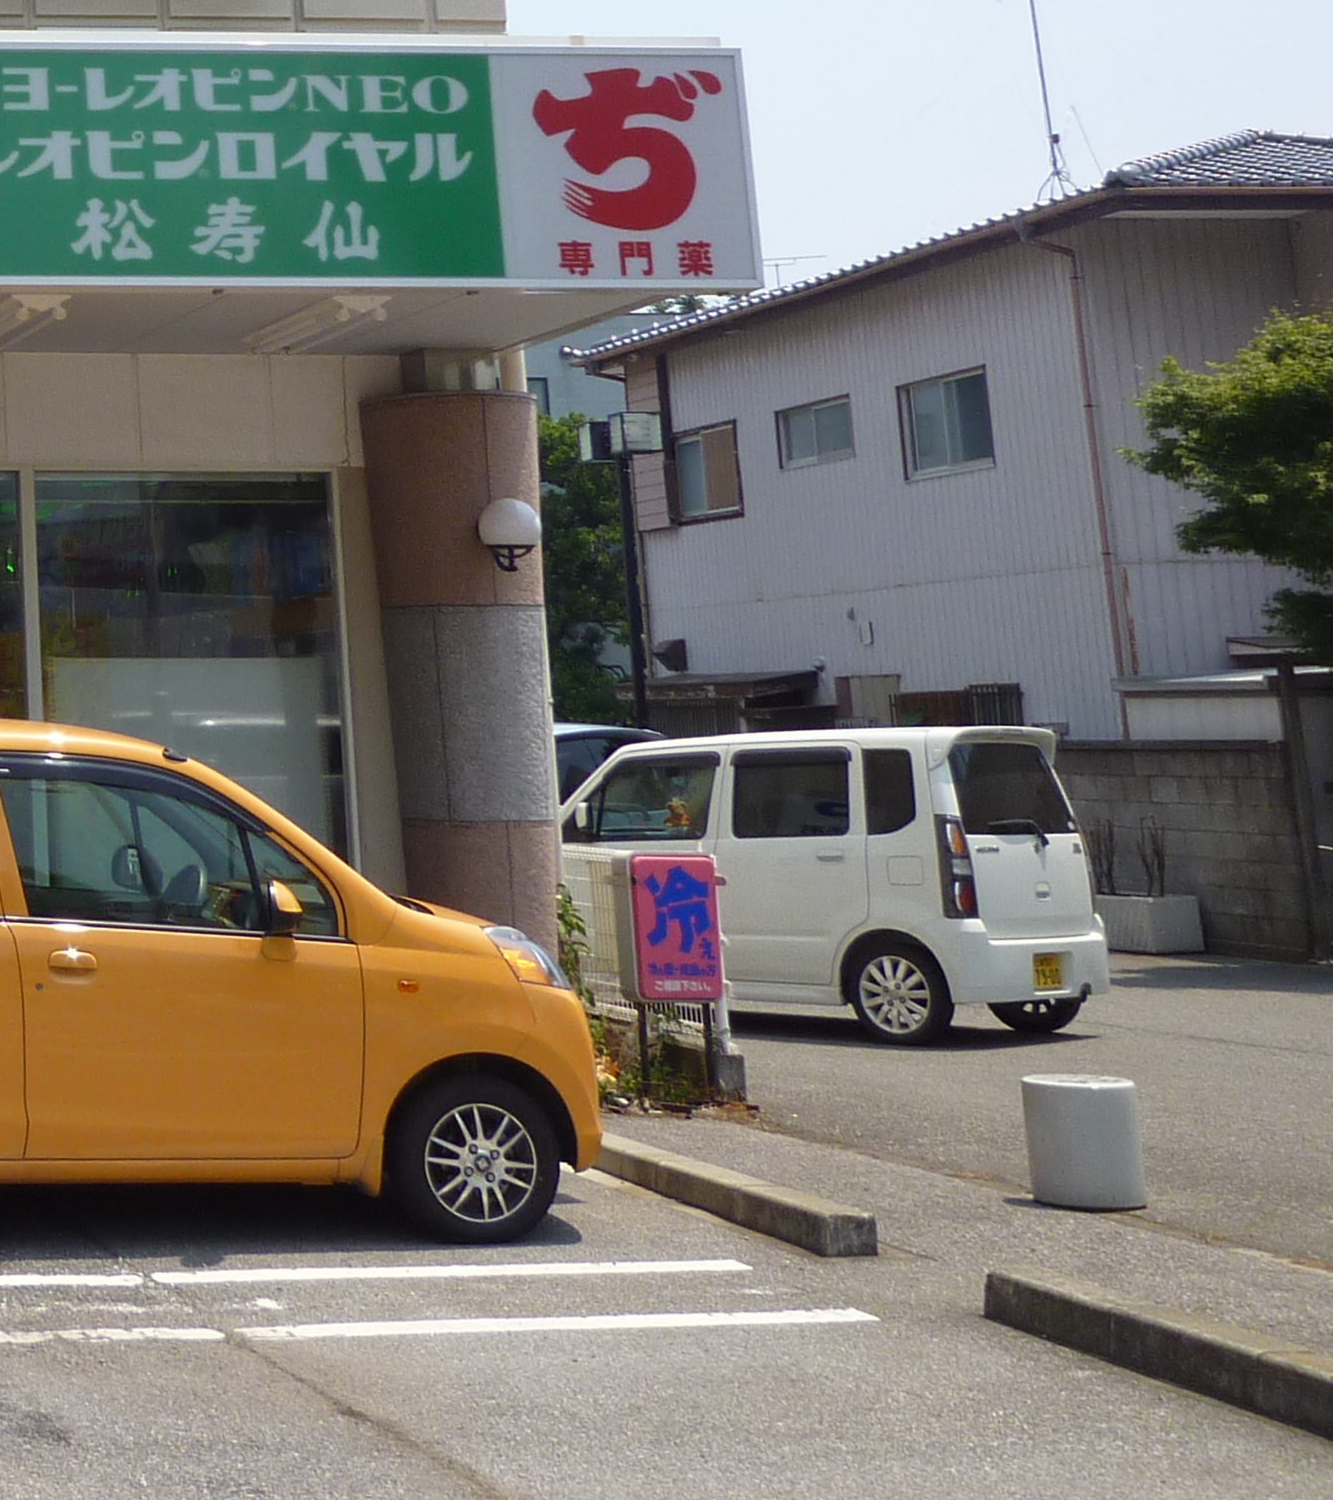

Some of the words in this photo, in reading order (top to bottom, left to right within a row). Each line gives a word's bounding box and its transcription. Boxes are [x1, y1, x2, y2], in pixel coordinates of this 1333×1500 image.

[532, 65, 723, 232] ぢ
[72, 197, 381, 263] 松寿仙
[558, 238, 716, 278] 専門薬
